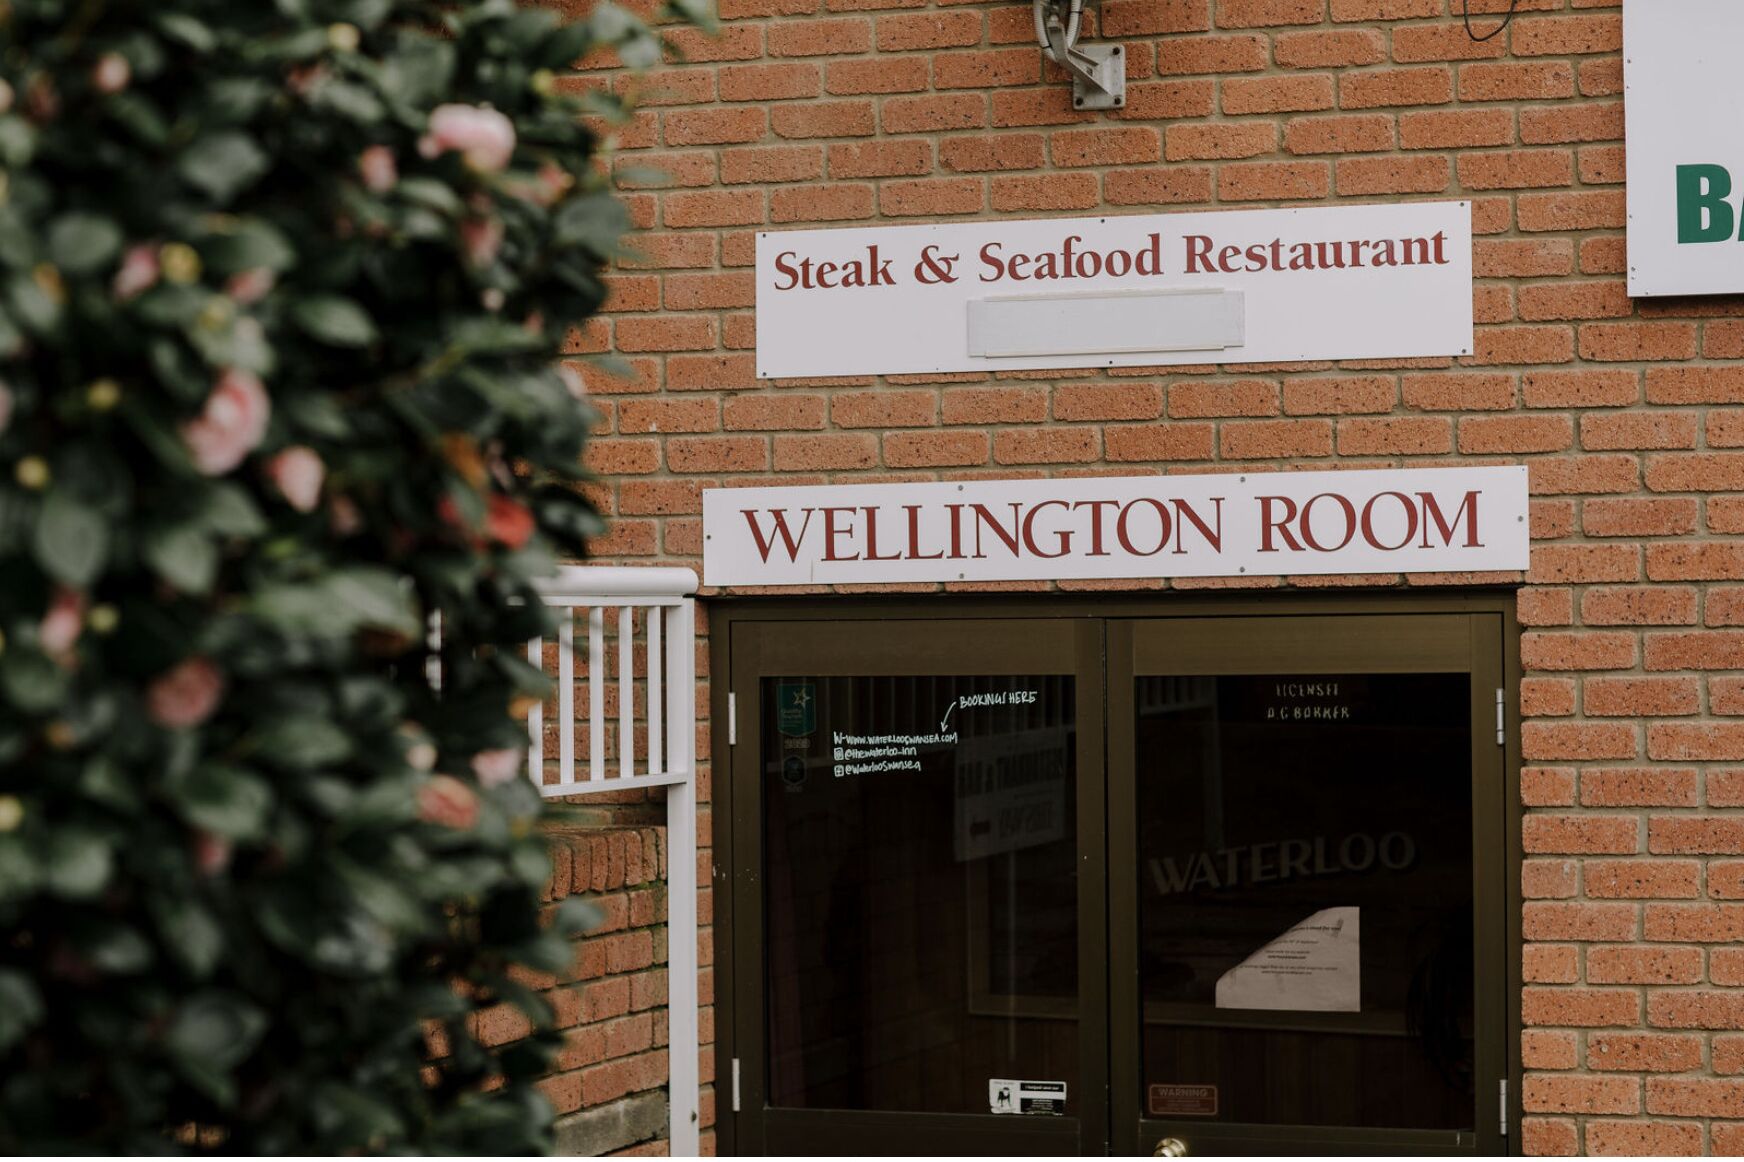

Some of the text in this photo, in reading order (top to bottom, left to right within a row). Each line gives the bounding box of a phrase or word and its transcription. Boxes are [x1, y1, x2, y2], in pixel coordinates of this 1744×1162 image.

[1676, 163, 1744, 244] B
[774, 230, 1451, 290] Steak & Seafood Restaurant
[739, 490, 1486, 565] WELLINGTON ROOM
[959, 690, 1038, 709] BOOKINGS HERE
[1149, 831, 1416, 894] WATERLOO
[1158, 1087, 1208, 1098] WARNING
